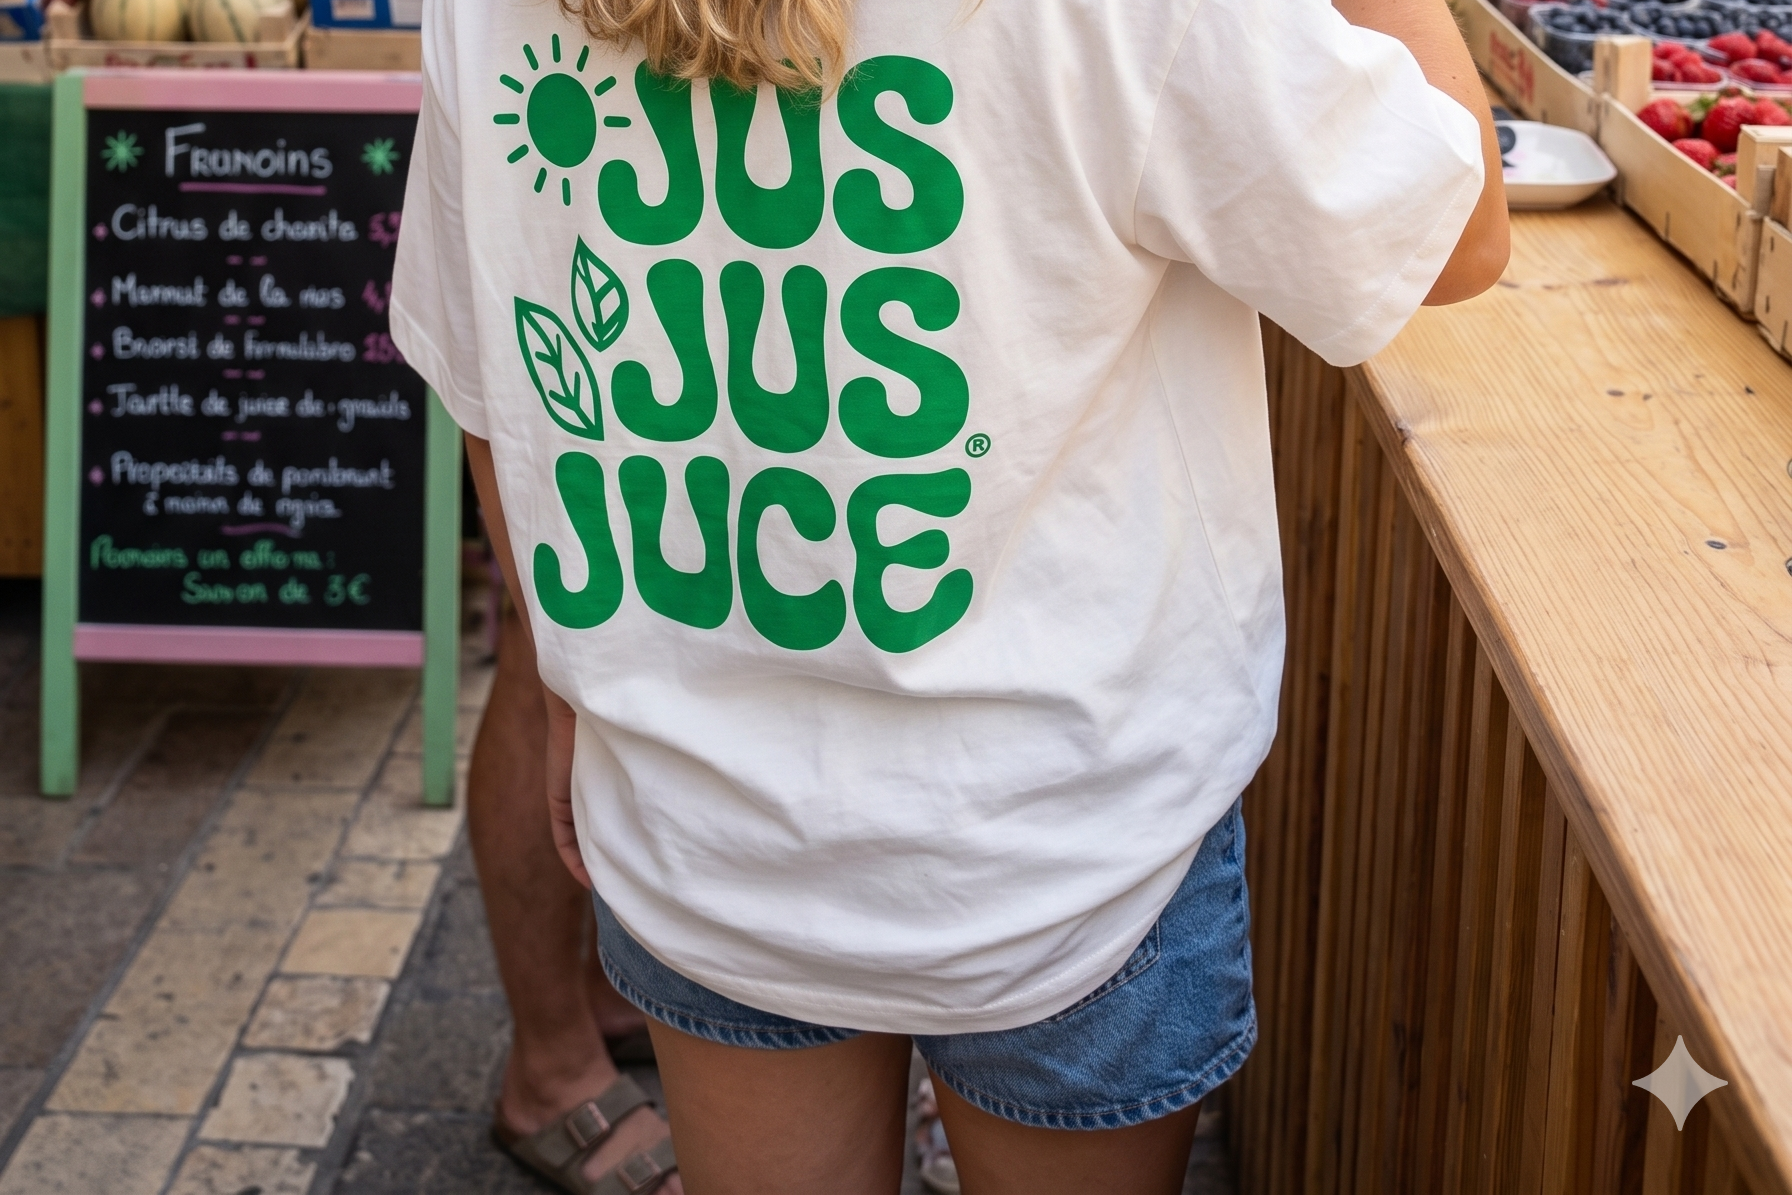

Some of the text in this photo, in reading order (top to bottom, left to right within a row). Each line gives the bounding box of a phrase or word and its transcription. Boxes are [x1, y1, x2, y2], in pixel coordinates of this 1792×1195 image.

[597, 55, 964, 254] JUS
[110, 203, 209, 242] Citrus
[218, 208, 253, 242] de
[217, 278, 250, 308] de
[206, 332, 236, 360] de
[610, 257, 970, 459] JUS
[201, 388, 232, 417] de
[247, 459, 276, 487] de
[237, 490, 266, 516] de
[533, 450, 974, 654] JUCE
[278, 576, 312, 605] de
